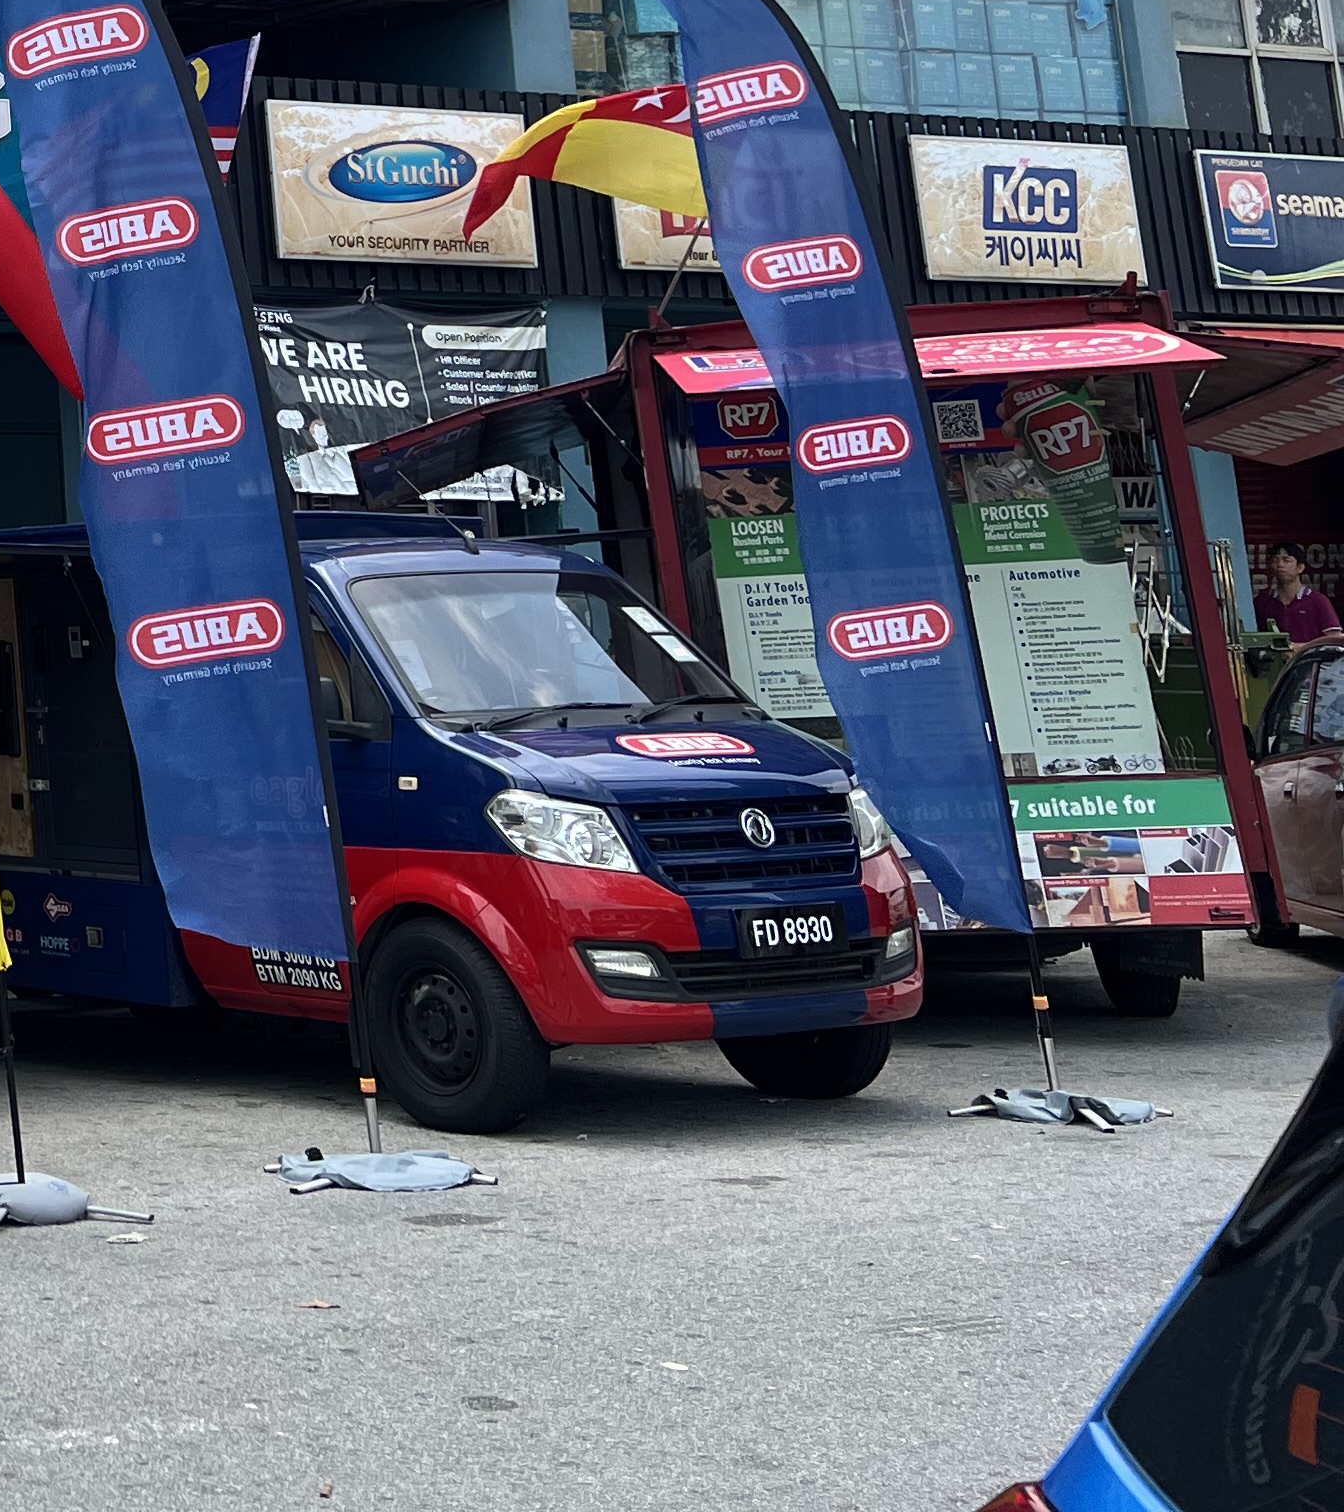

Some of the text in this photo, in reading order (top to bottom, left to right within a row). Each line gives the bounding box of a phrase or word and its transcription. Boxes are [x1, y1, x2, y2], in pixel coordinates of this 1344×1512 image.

[347, 153, 460, 189] StGuchi
[993, 158, 1070, 224] KCC
[329, 234, 490, 254] YOUR SECURITY PARTNER
[985, 235, 1083, 269] 케이씨씨
[435, 332, 462, 343] Open
[307, 341, 368, 371] ARE
[443, 369, 483, 379] Customer
[298, 375, 410, 408] HIRING
[446, 382, 468, 391] Sales
[449, 395, 472, 404] Stock
[724, 402, 770, 427] RP7
[1031, 415, 1090, 459] RP7
[756, 448, 783, 458] Your
[980, 504, 1049, 521] PROTECTS
[731, 519, 784, 536] LOOSEN
[983, 521, 1030, 532] Against Rust
[985, 531, 1046, 541] Metal Corrosion
[1009, 568, 1080, 581] Automotive
[774, 581, 804, 592] Tools
[747, 596, 788, 607] Garden
[638, 736, 730, 752] ABUS
[1027, 795, 1118, 818] suitable
[1123, 794, 1156, 814] for
[753, 915, 832, 948] FD 8930
[40, 936, 70, 950] HOPPE
[256, 964, 342, 990] BTM 2090 KG
